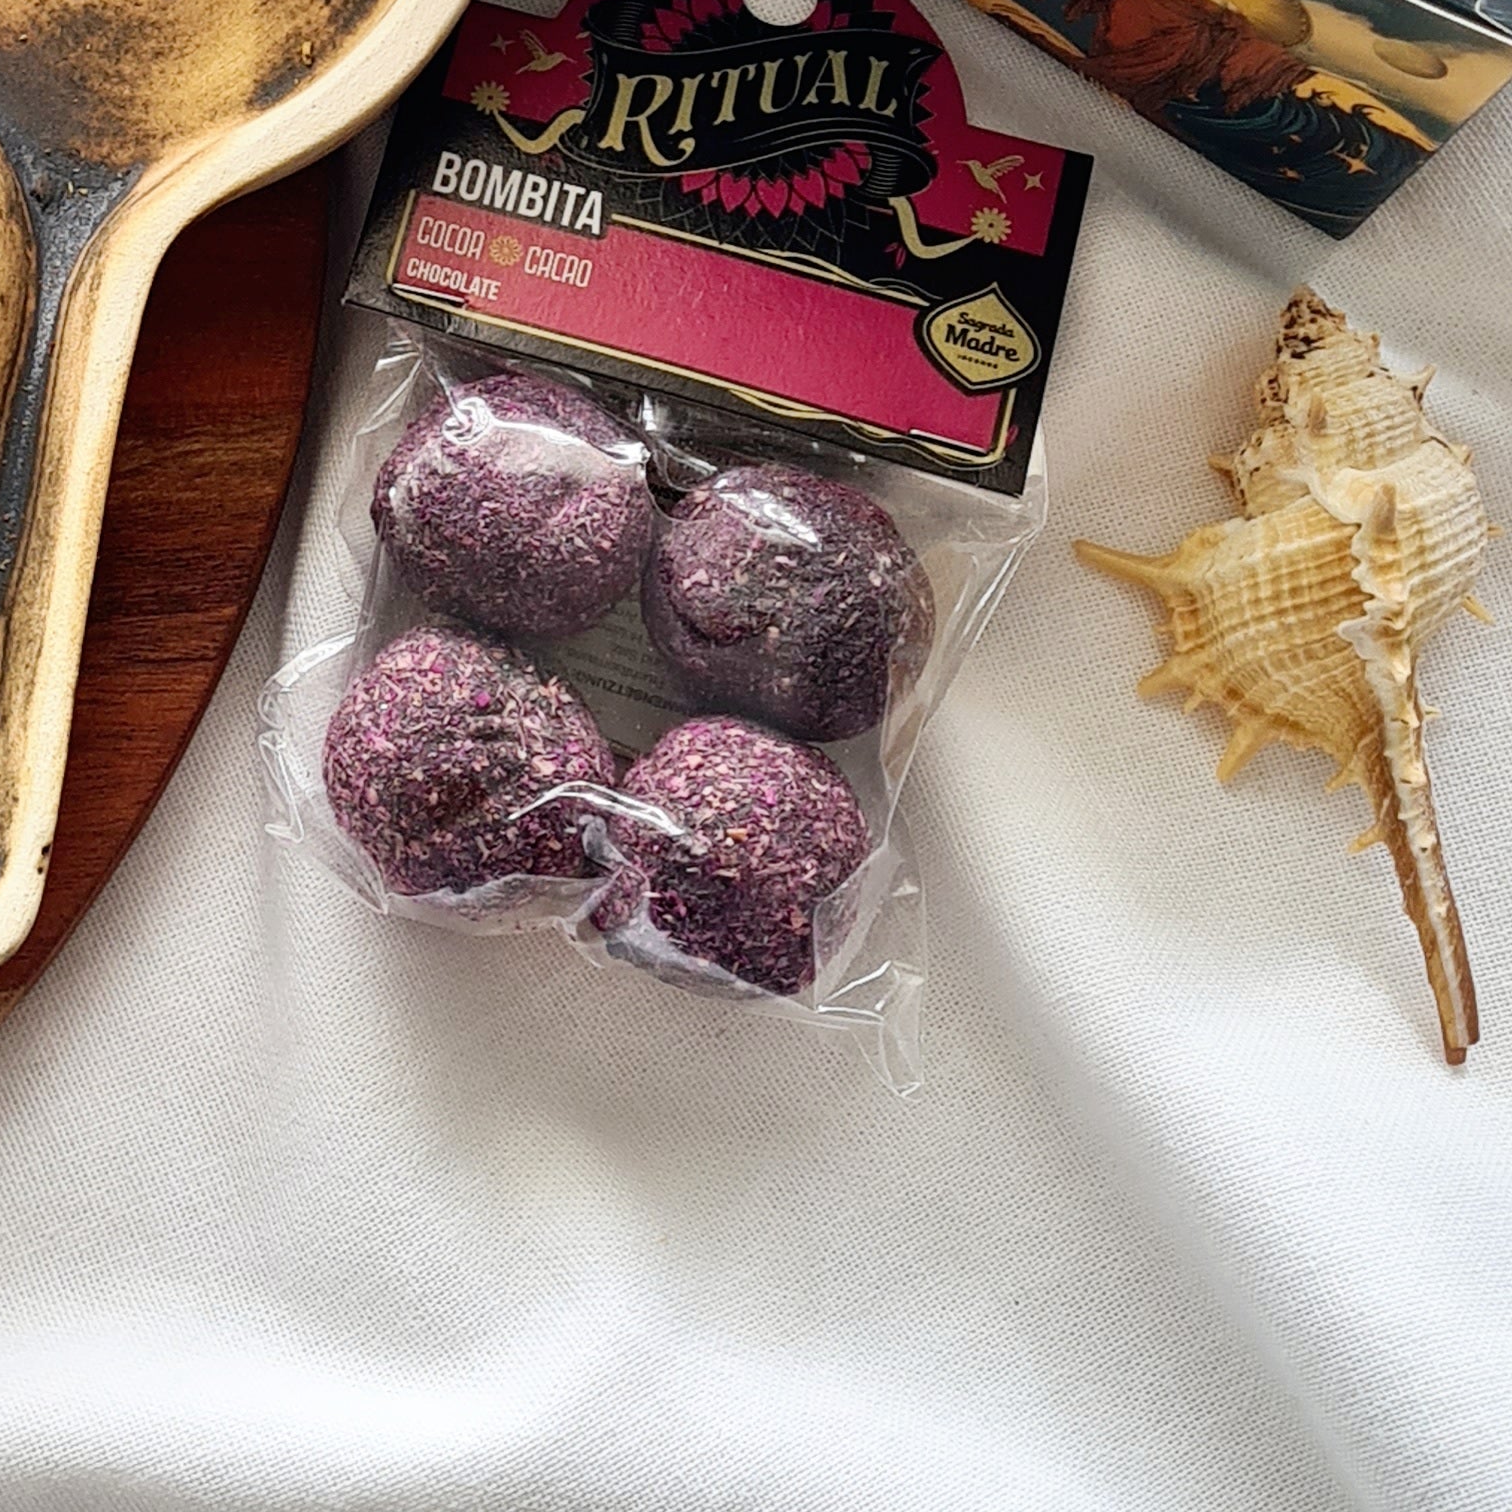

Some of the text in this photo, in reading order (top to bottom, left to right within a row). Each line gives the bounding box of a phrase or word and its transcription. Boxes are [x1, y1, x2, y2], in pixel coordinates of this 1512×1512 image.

[599, 49, 898, 169] RITUAL
[431, 150, 604, 236] BOMBITA
[404, 256, 501, 302] CHOCOLATE
[416, 214, 593, 290] COCOA CACAO
[944, 324, 1020, 362] Madre
[957, 311, 1015, 339] Sagrada
